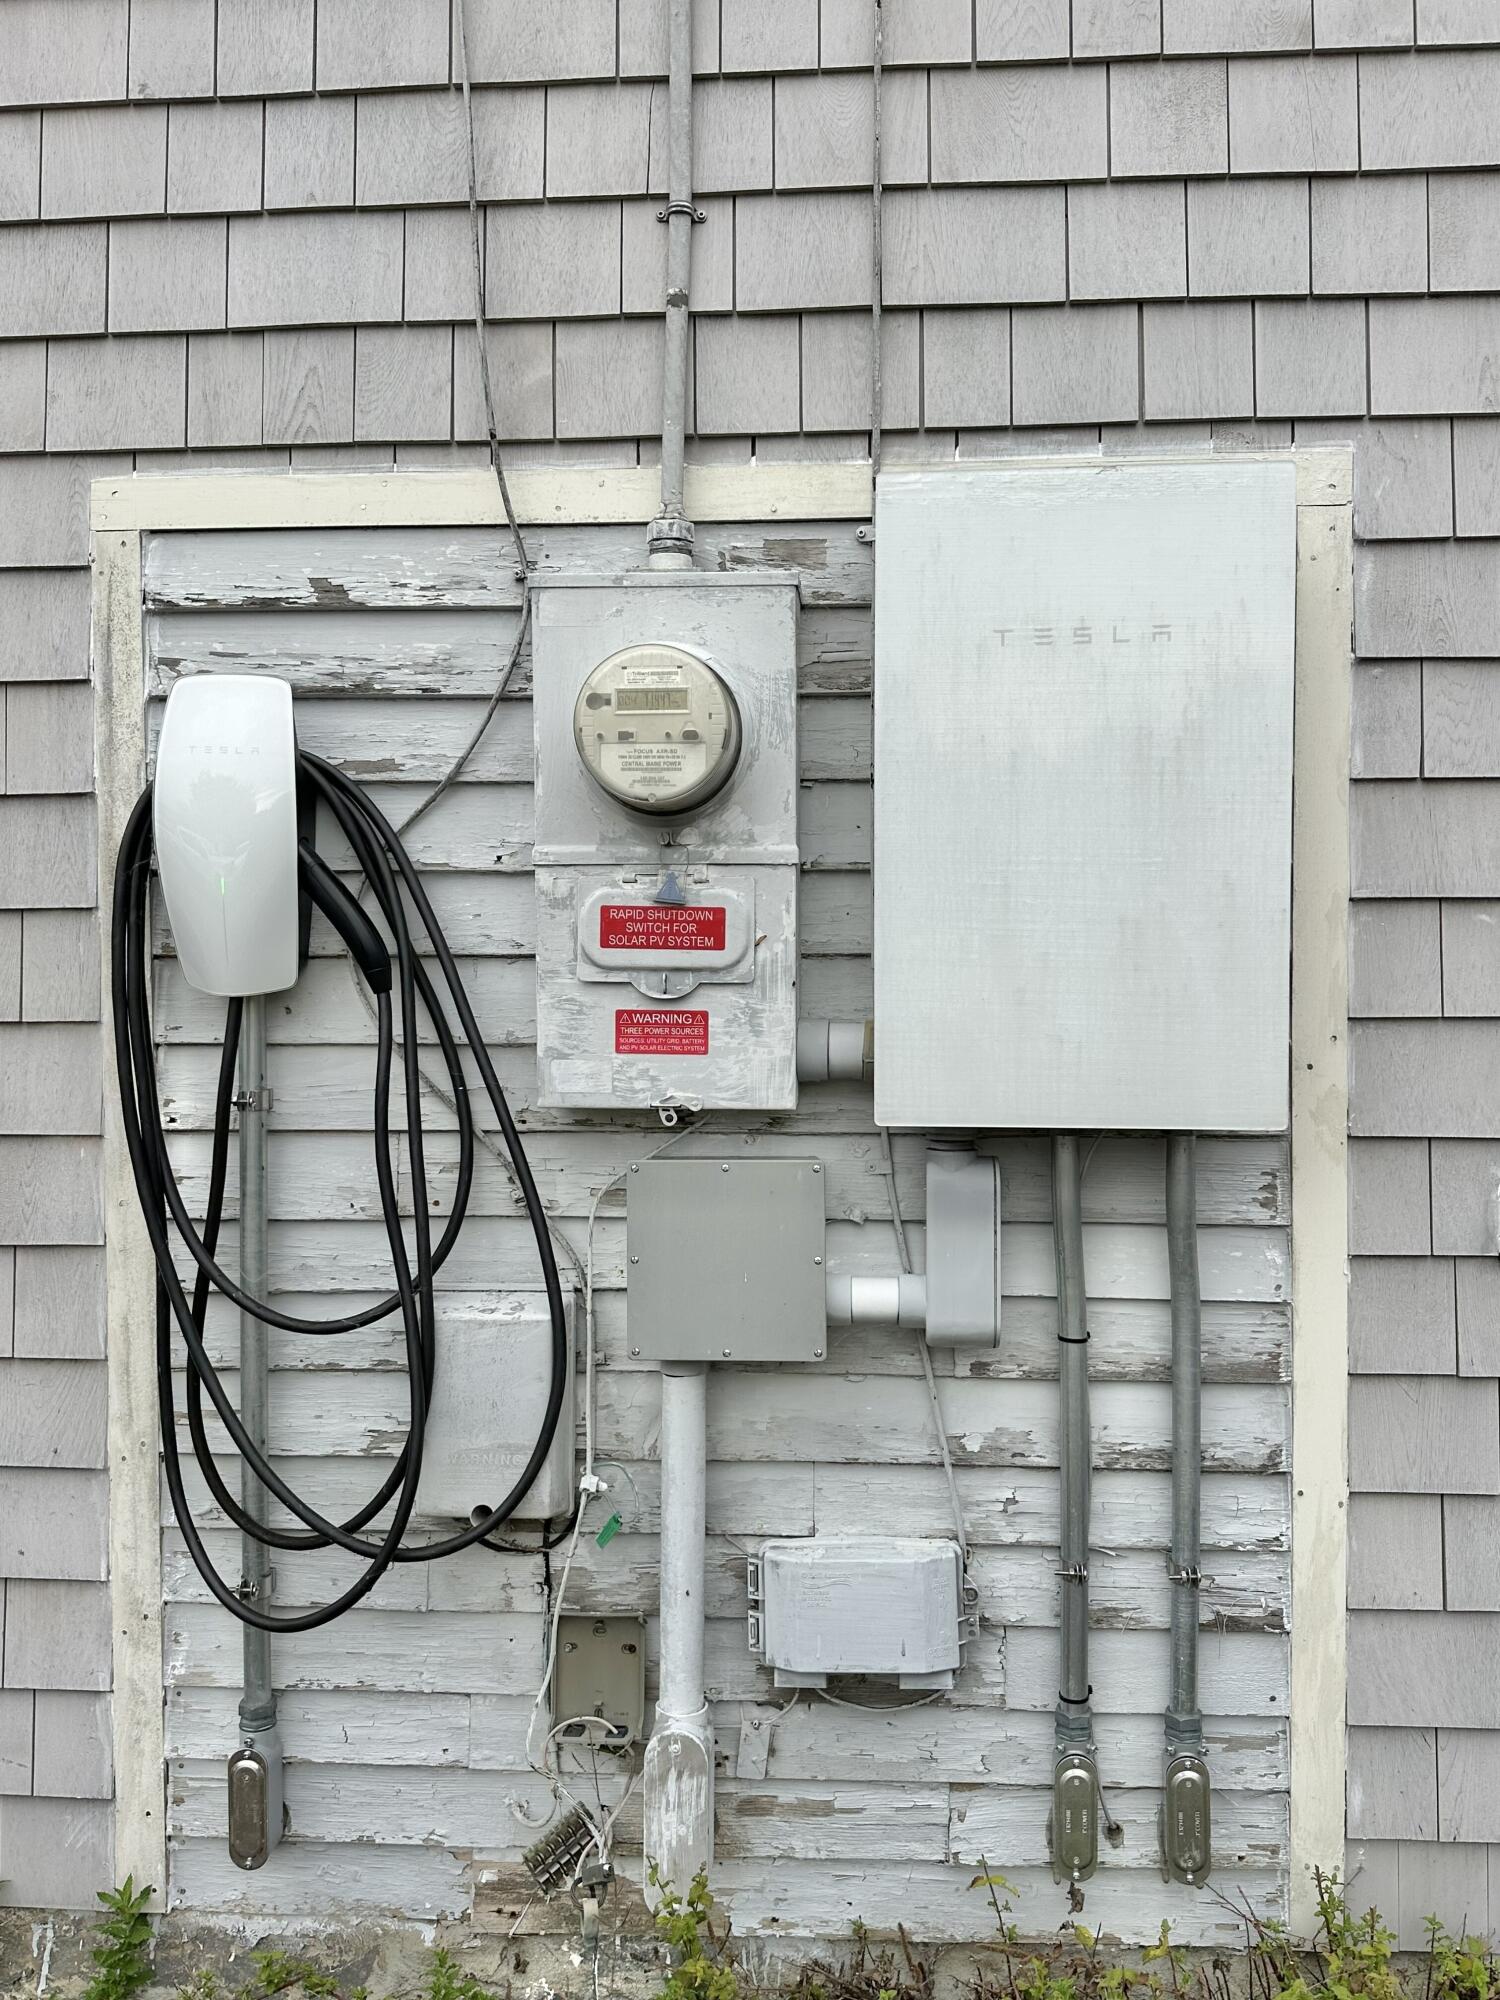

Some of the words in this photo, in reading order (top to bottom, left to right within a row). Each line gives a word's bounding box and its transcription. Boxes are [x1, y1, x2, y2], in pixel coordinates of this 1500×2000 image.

[993, 624, 1172, 647] TESLA
[188, 745, 261, 755] TESLA
[609, 908, 644, 920] RAPID
[647, 909, 713, 921] SHUTDOWN
[625, 921, 670, 933] SWITCH
[673, 922, 697, 933] FOR
[608, 934, 647, 945] SOLAR
[650, 935, 665, 946] PV
[668, 936, 714, 947] SYSTEM
[632, 1013, 692, 1024] WARNING
[621, 1027, 643, 1035] THREE
[644, 1027, 670, 1035] POWER
[671, 1027, 704, 1036] SOURCES
[448, 1453, 523, 1466] WARNING
